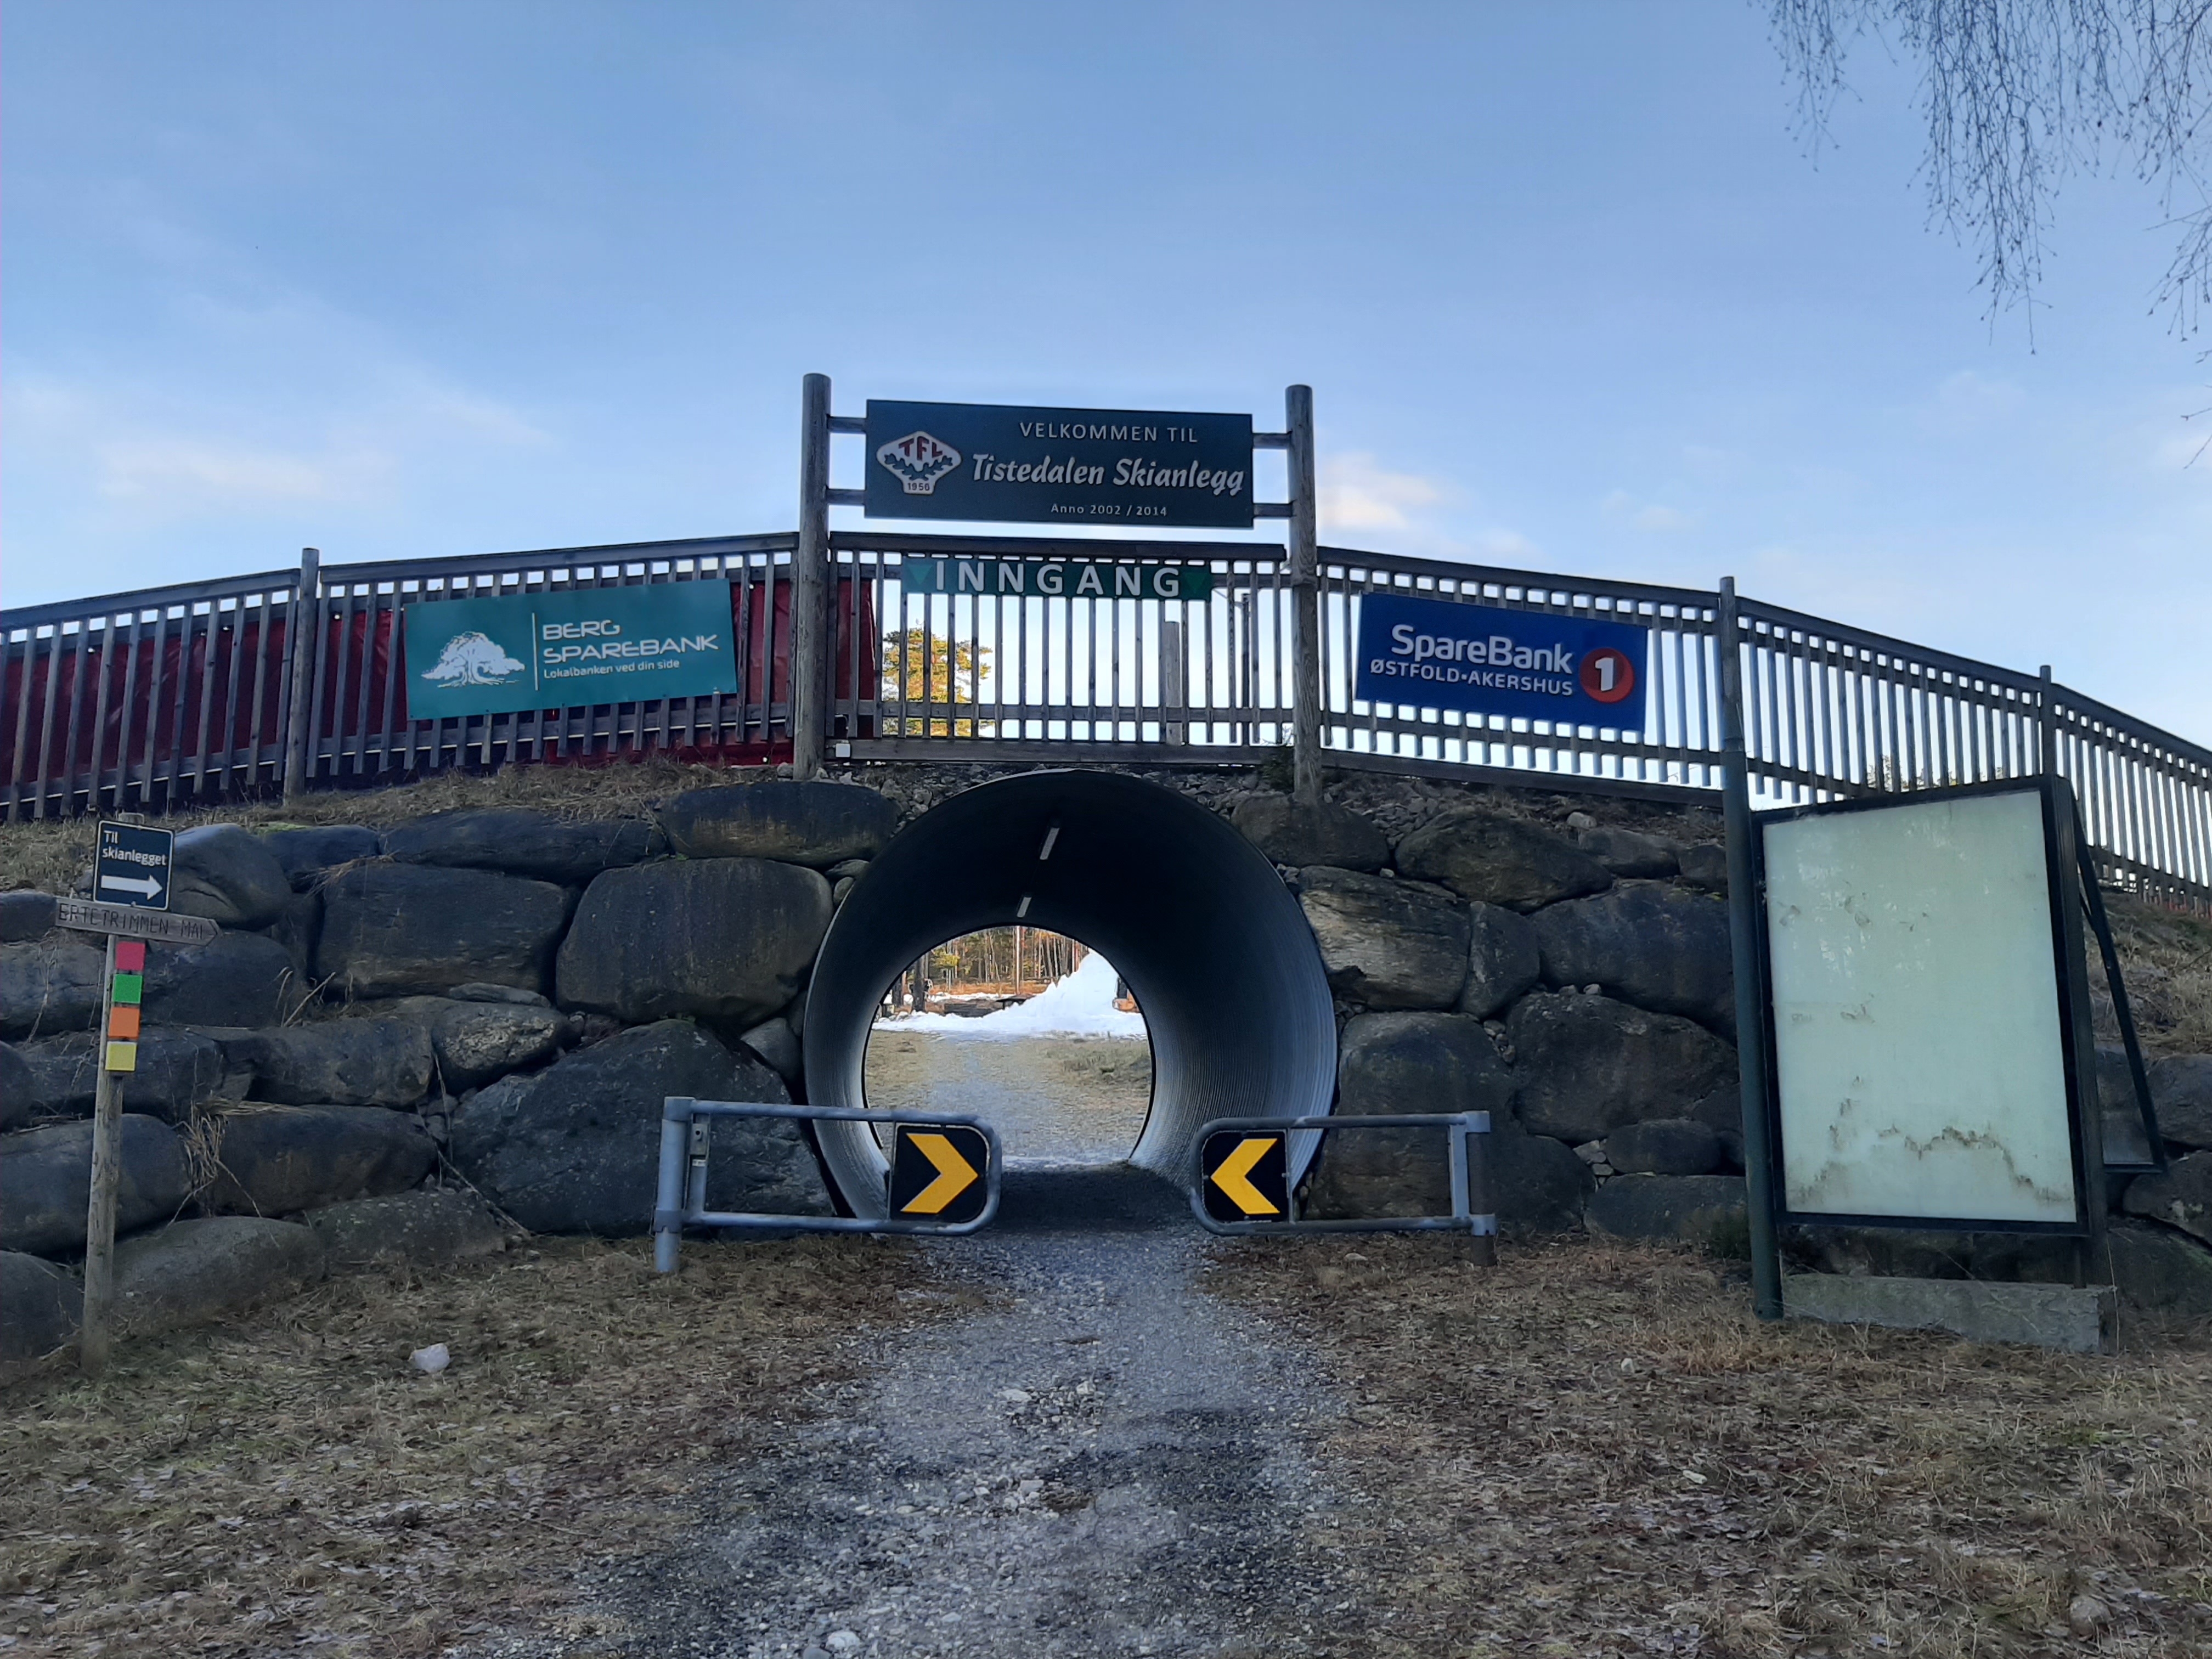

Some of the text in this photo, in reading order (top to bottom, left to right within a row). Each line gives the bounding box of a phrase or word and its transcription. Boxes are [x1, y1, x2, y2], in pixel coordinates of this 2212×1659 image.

[1019, 421, 1198, 443] VELKOMMEN TIL
[898, 436, 943, 462] TFL
[972, 454, 1245, 496] Tistedalen Skianlegg
[1051, 503, 1084, 514] Anno
[1090, 504, 1121, 515] 2002
[1136, 506, 1167, 517] 2014
[936, 561, 1180, 597] INNGANG
[543, 619, 620, 640] BERG
[543, 634, 719, 664] SPAREBANK
[1391, 624, 1616, 692] SpareBank 1
[544, 658, 680, 679] Lokalbanken ved din side
[104, 830, 118, 844] Til
[102, 845, 166, 866] skianlegget
